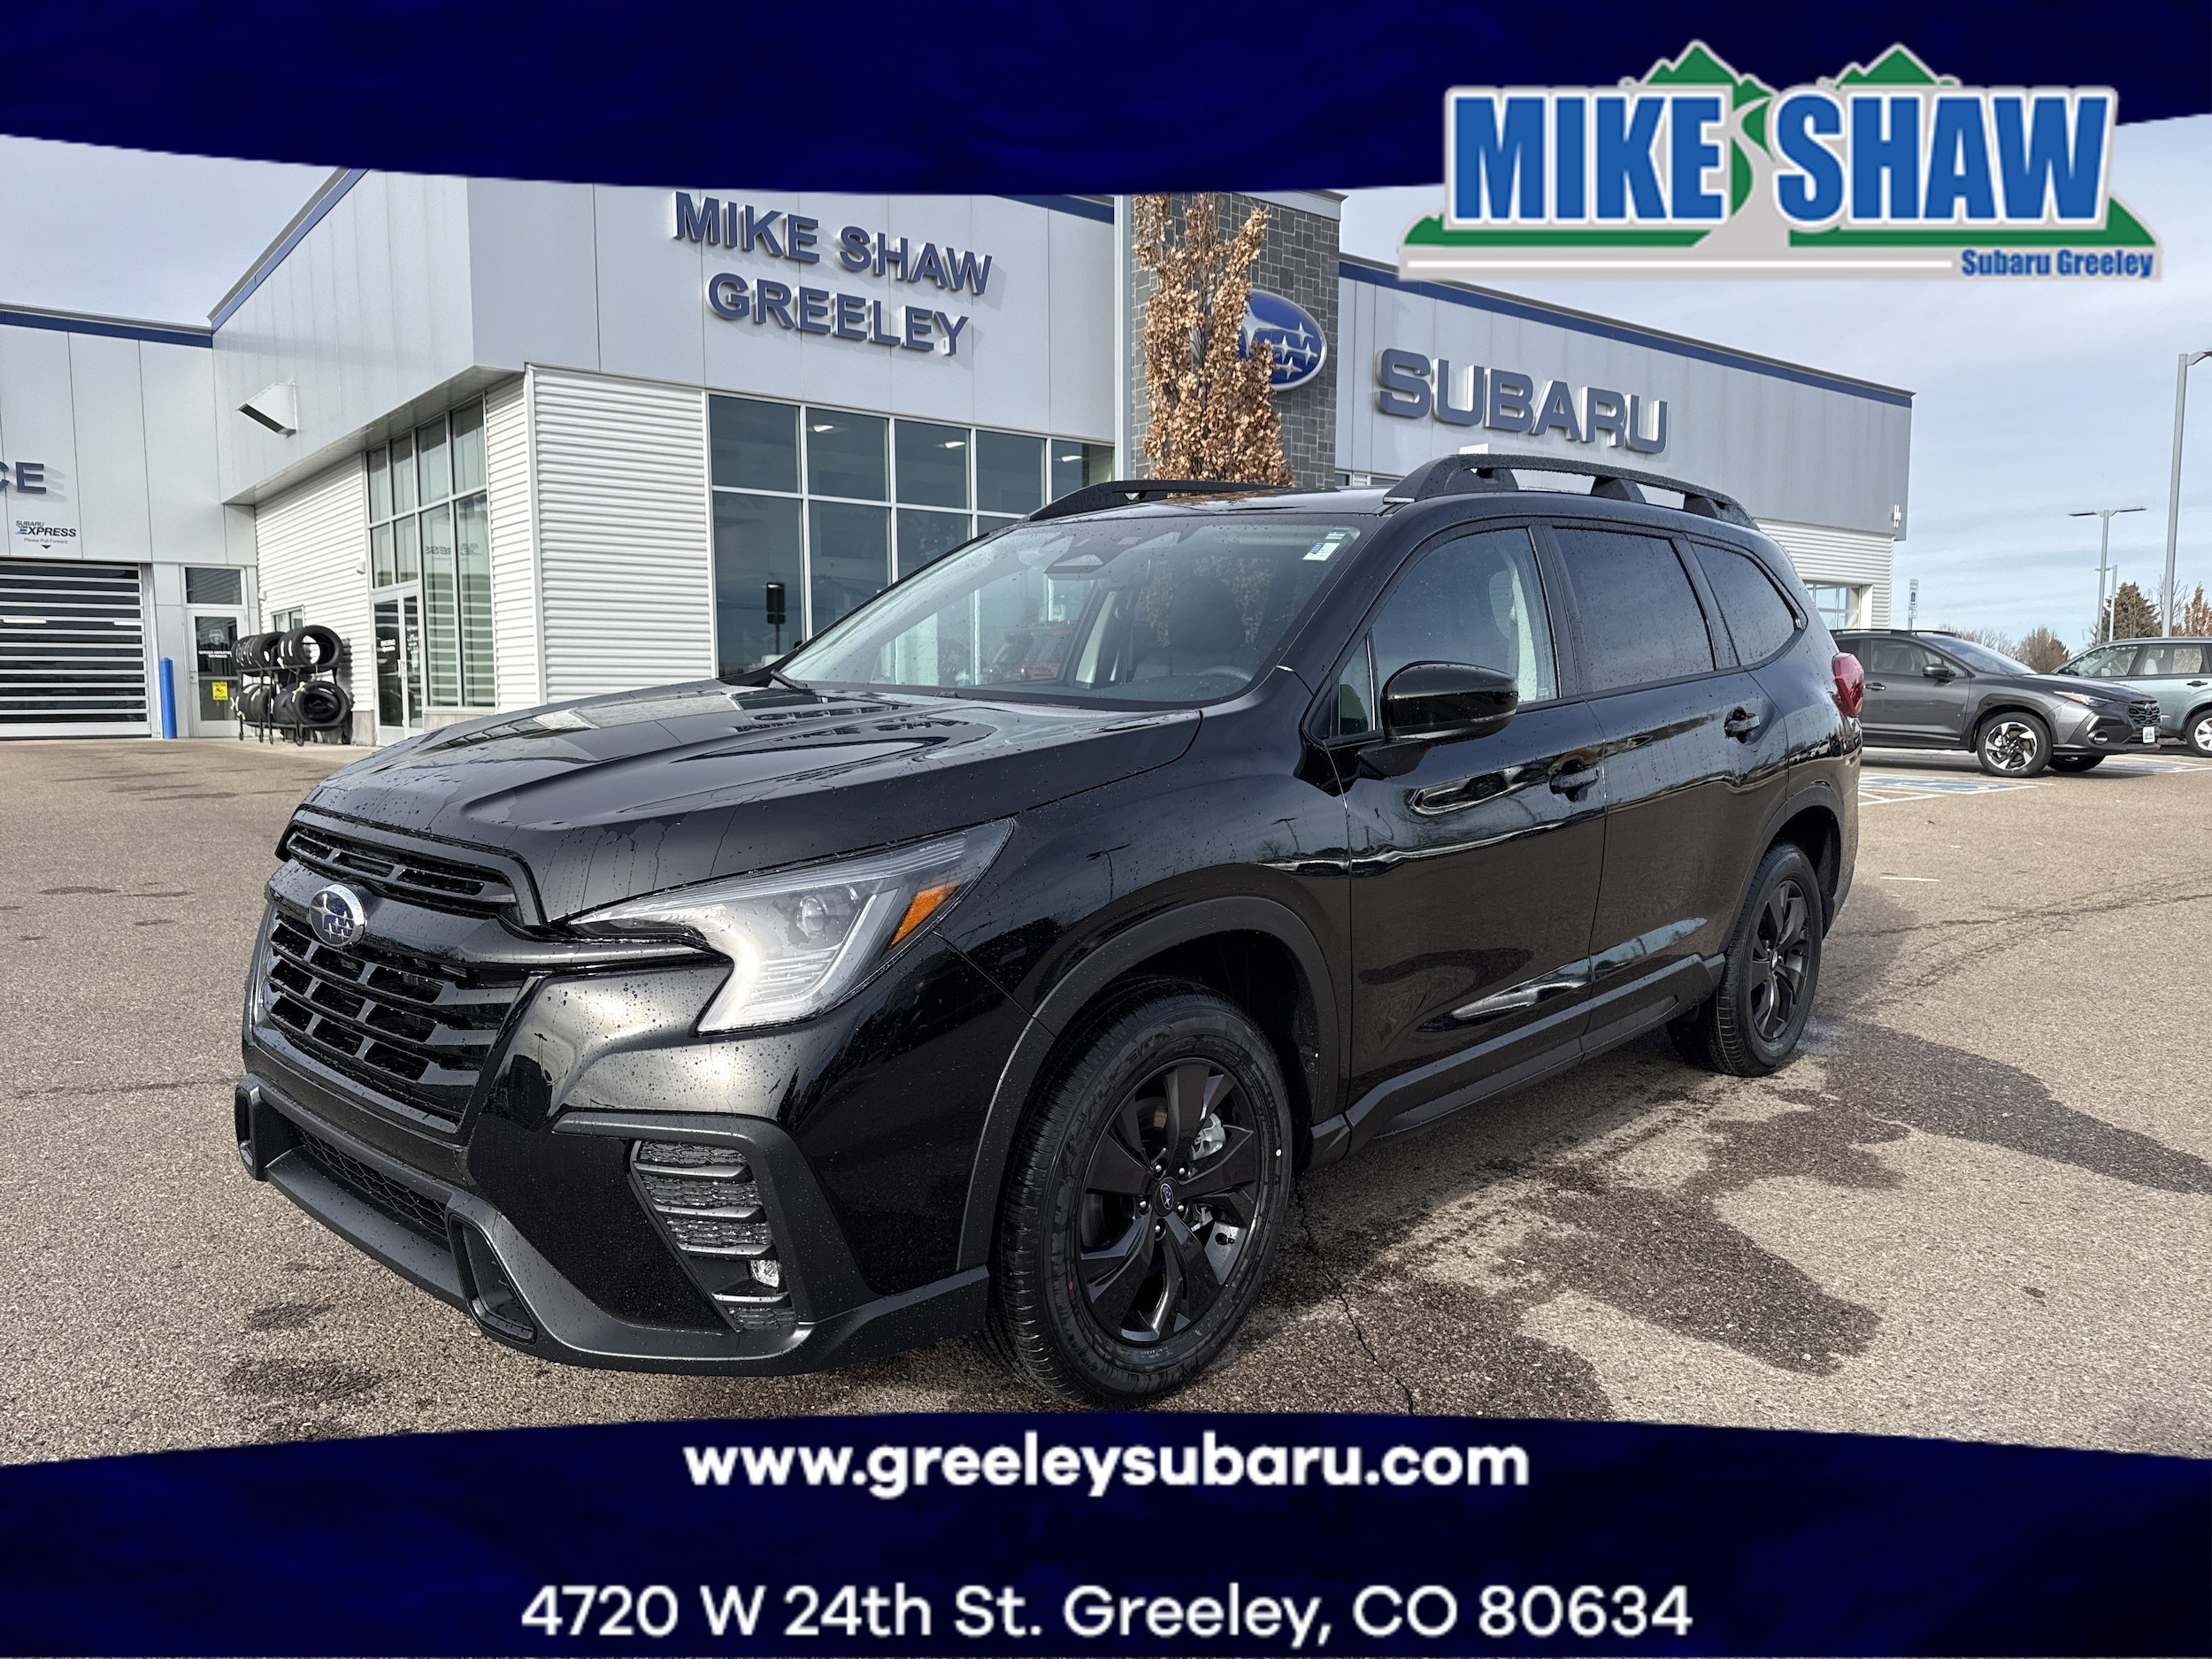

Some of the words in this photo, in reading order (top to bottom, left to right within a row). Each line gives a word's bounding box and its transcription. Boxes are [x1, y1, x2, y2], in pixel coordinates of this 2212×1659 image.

[672, 191, 820, 263] MIKE
[835, 226, 993, 295] SHAW
[706, 273, 969, 355] GREELEY
[1374, 348, 1668, 454] SUBARU
[15, 526, 77, 537] EXPRESS
